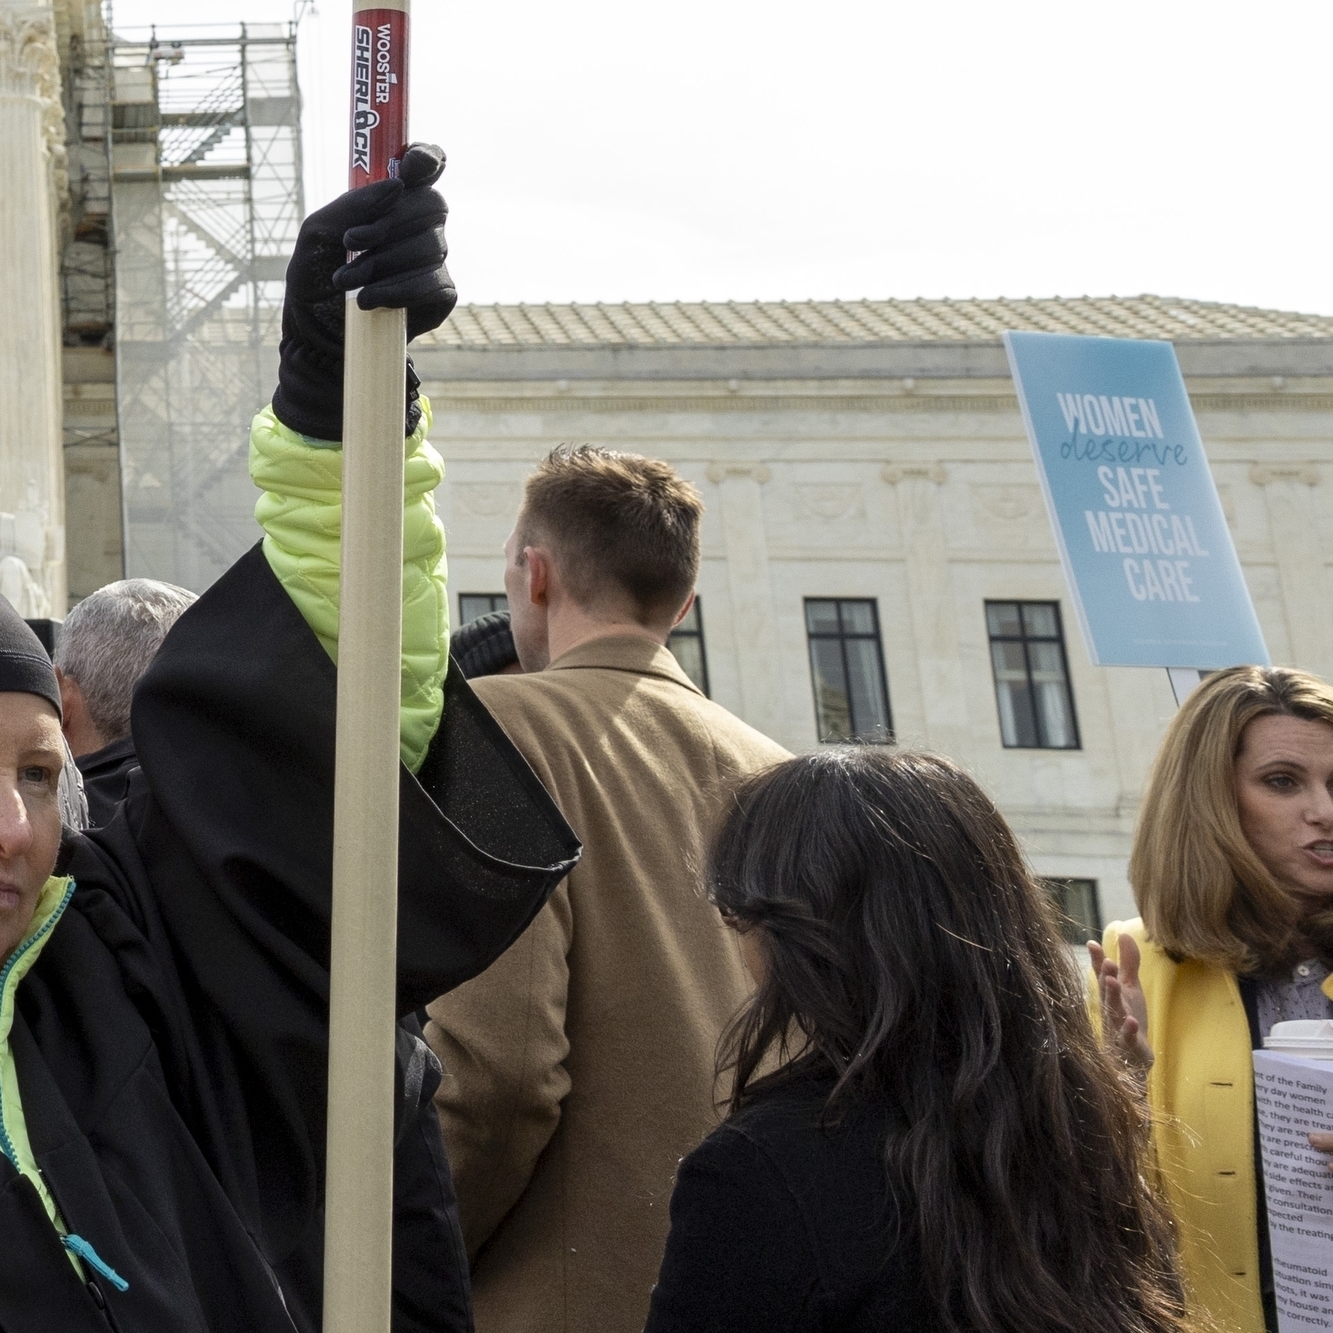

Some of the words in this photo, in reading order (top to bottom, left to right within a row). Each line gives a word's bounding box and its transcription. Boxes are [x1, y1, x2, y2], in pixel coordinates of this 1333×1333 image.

[376, 23, 391, 104] WOOSTER
[1056, 392, 1164, 438] WOMEN
[1060, 418, 1188, 466] deserve
[1097, 466, 1170, 510] SAFE
[1084, 511, 1210, 557] MEDICAL
[1123, 559, 1201, 603] CARE
[1266, 1074, 1275, 1083] of
[1278, 1077, 1294, 1087] the
[1296, 1080, 1328, 1095] Family
[1270, 1088, 1287, 1099] day
[1290, 1093, 1326, 1106] women
[1274, 1100, 1290, 1111] the
[1293, 1104, 1324, 1118] health
[1270, 1111, 1291, 1123] they
[1294, 1117, 1309, 1126] are
[1278, 1125, 1293, 1134] are
[1266, 1134, 1282, 1144] are
[1270, 1148, 1303, 1161] careful
[1273, 1161, 1289, 1171] are
[1289, 1175, 1322, 1189] effects
[1297, 1190, 1323, 1201] Their
[1273, 1198, 1333, 1216] consultation
[1279, 1223, 1295, 1234] the
[1300, 1288, 1308, 1297] it
[1309, 1293, 1330, 1303] was
[1290, 1299, 1319, 1312] house
[1287, 1310, 1331, 1328] correctly.
